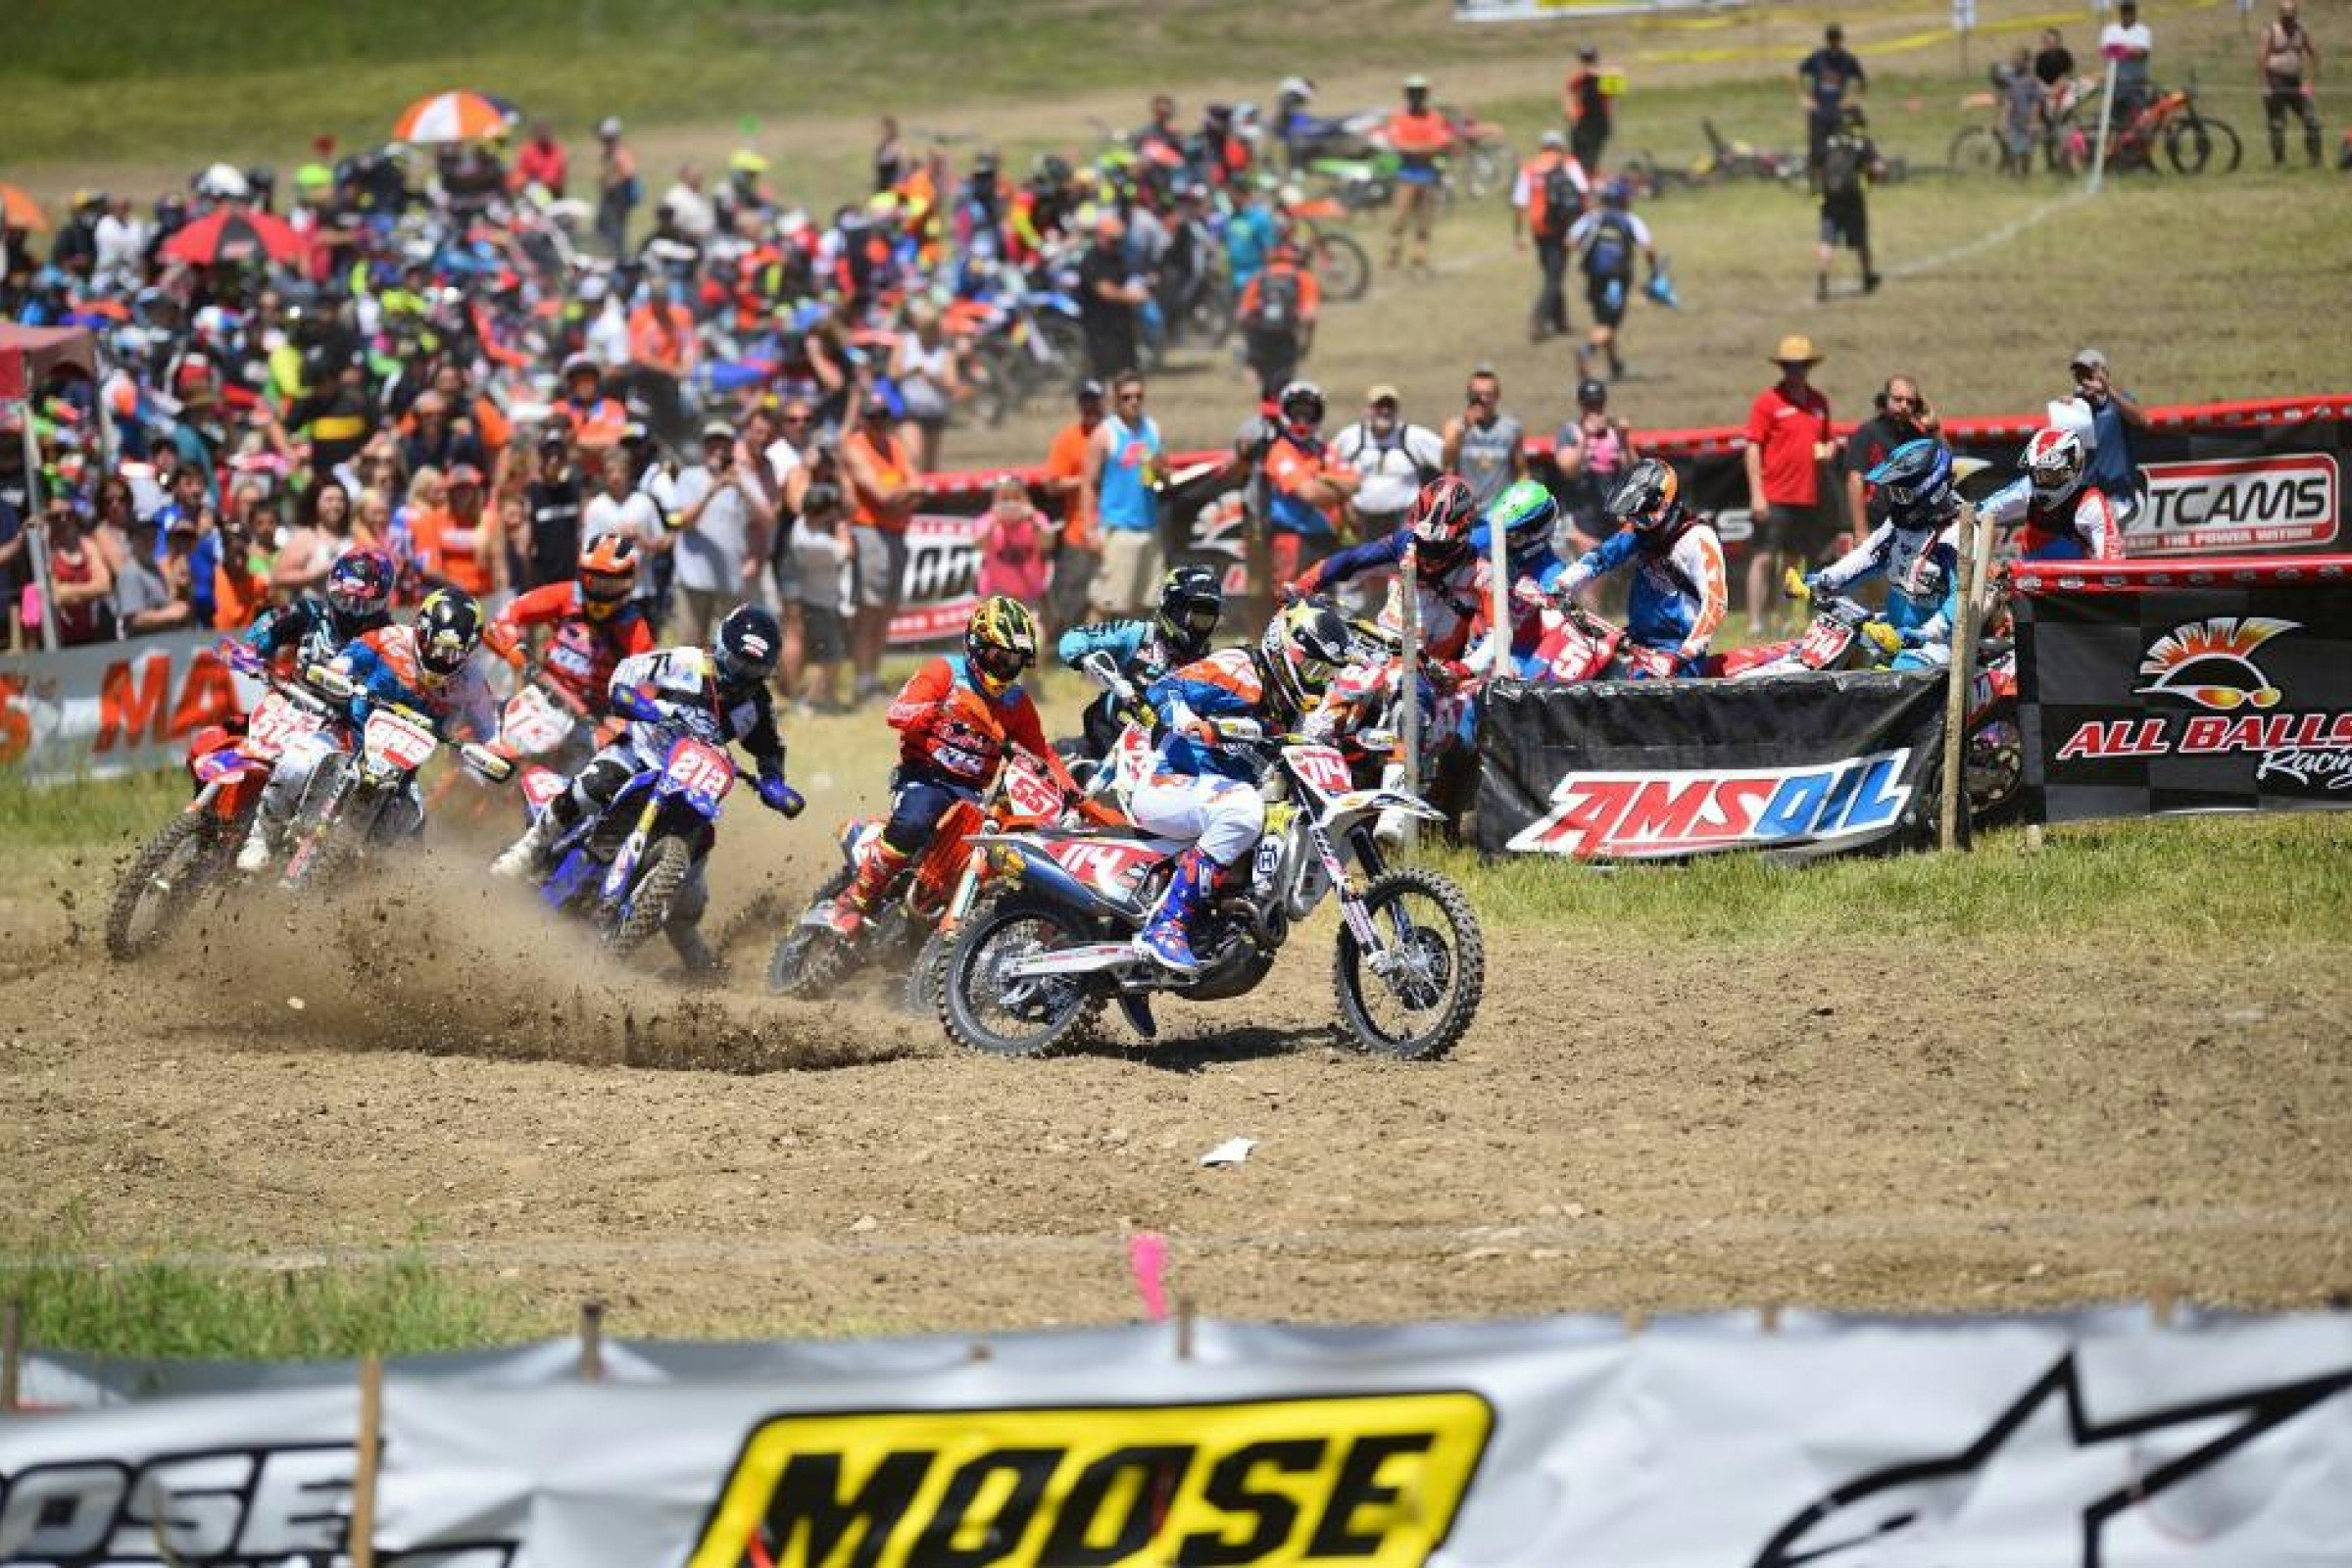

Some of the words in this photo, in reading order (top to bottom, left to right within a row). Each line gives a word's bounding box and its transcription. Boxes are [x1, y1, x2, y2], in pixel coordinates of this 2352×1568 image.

[2056, 718, 2171, 760] ALL
[1531, 758, 1901, 858] AMSOIL
[735, 1434, 1436, 1568] MOOSE
